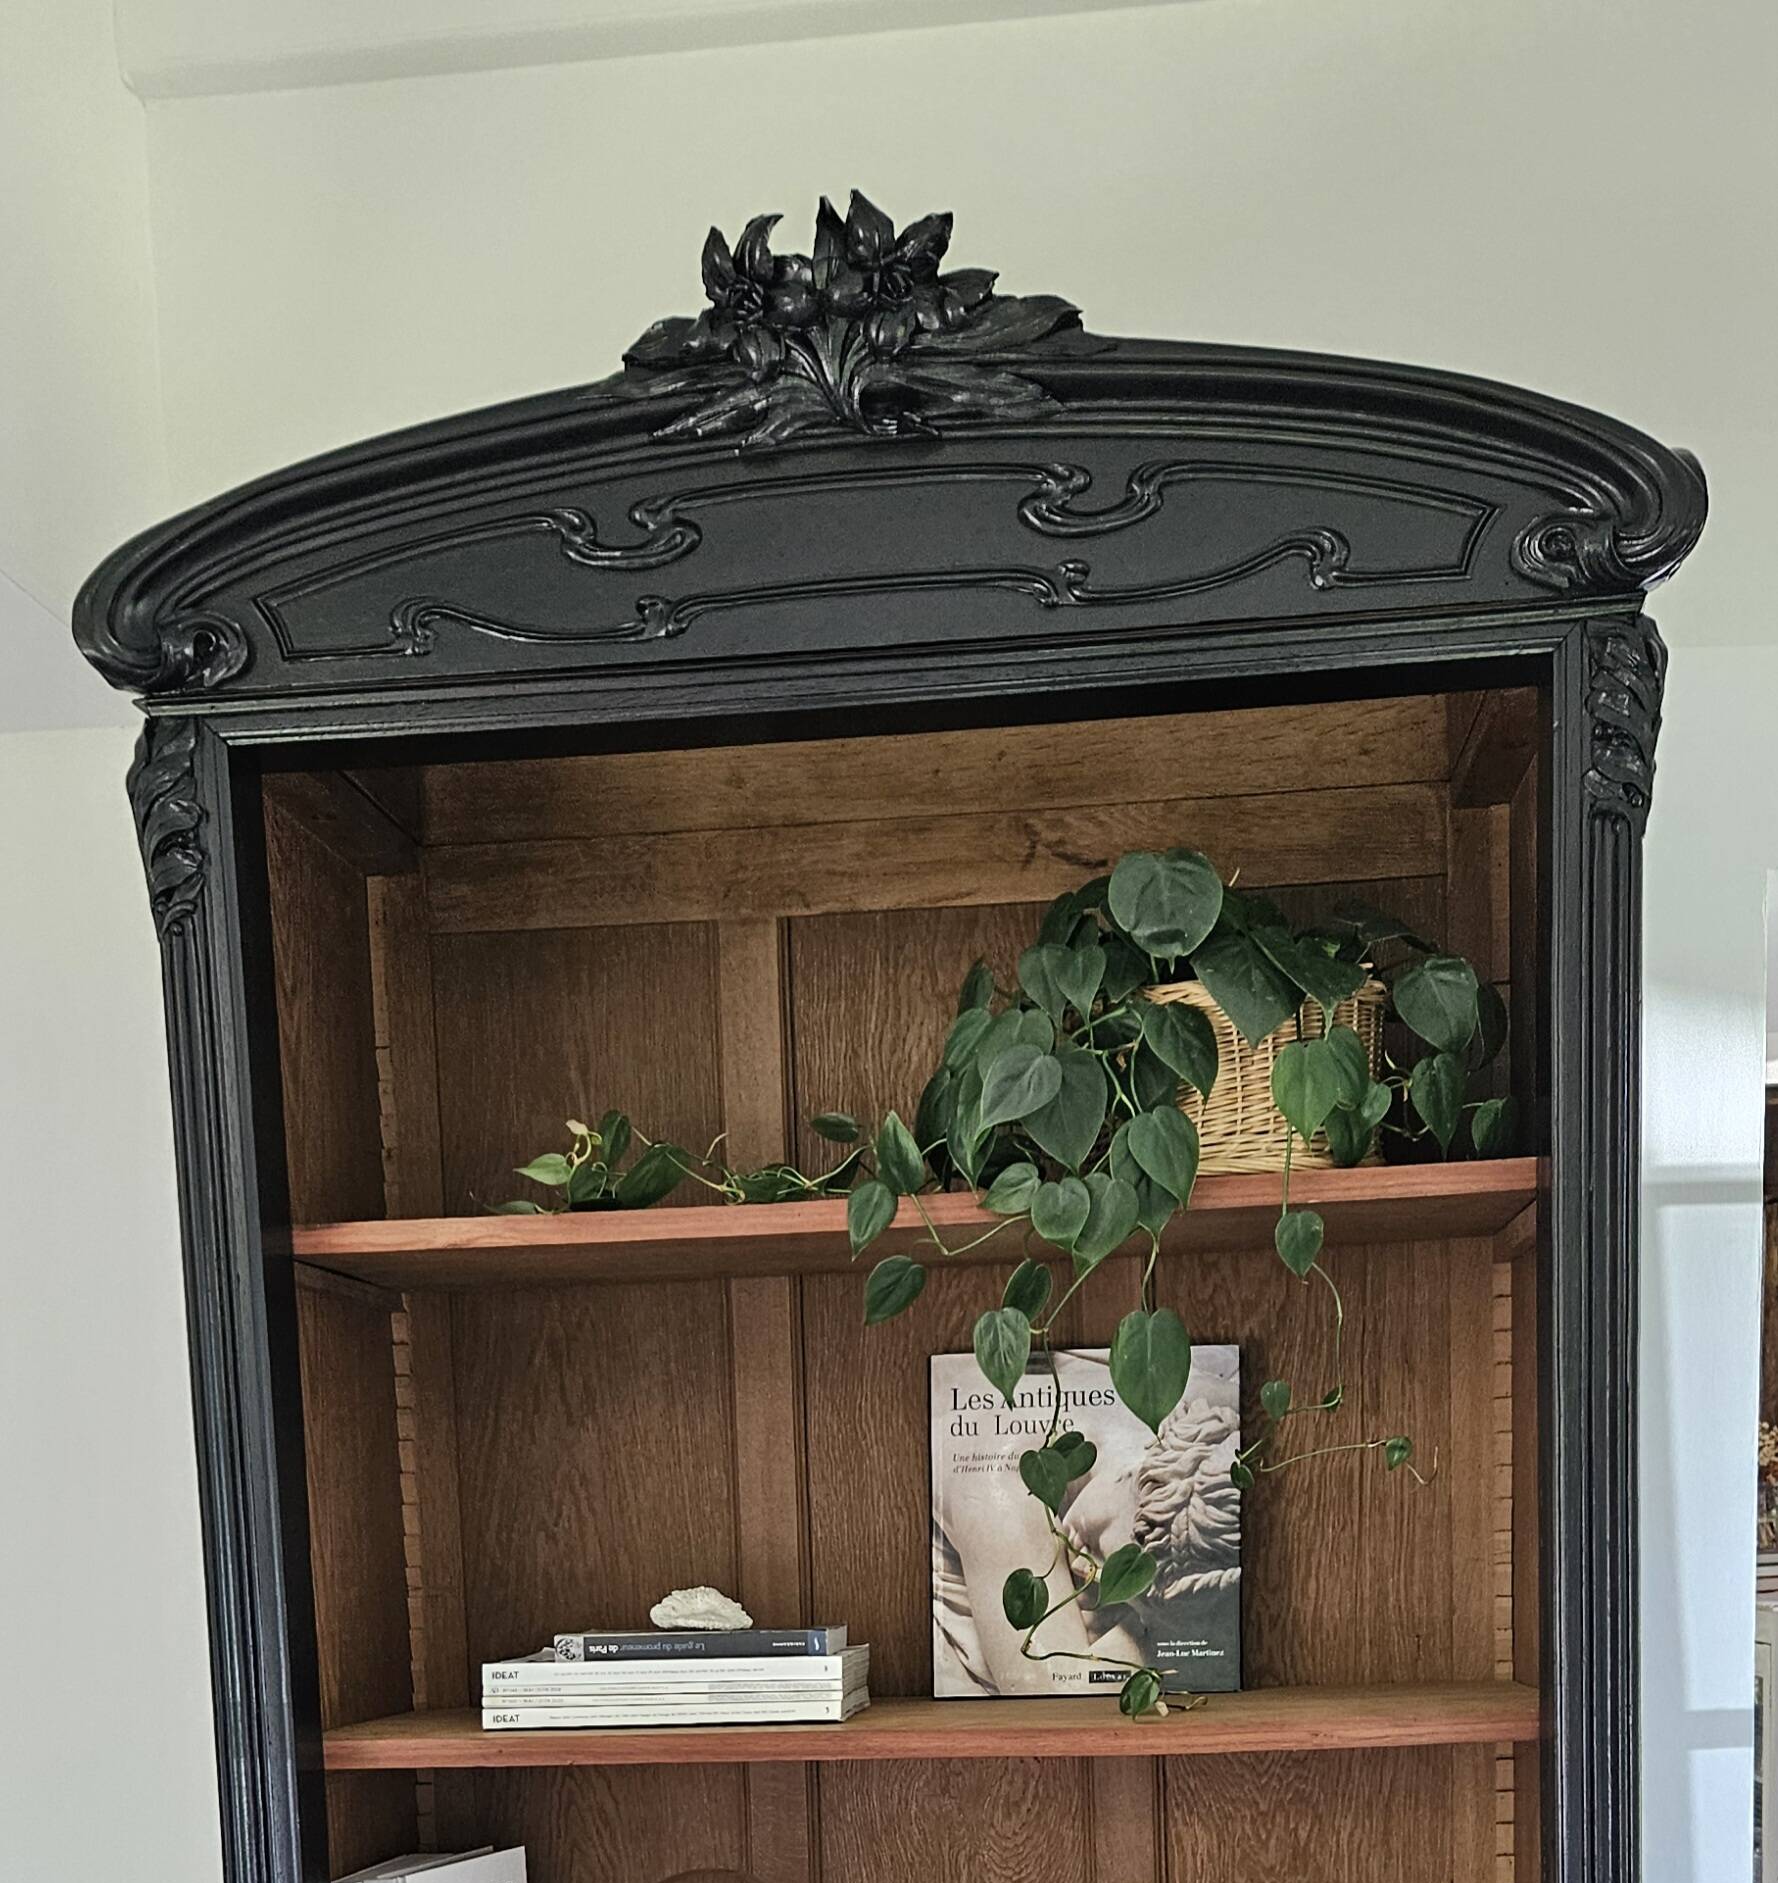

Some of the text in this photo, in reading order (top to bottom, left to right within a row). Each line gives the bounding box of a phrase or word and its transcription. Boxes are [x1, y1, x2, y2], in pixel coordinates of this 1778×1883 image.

[950, 1387, 994, 1411] Les
[950, 1413, 1074, 1436] du Louve
[952, 1453, 970, 1462] Une
[972, 1452, 1006, 1463] histoire
[589, 1644, 607, 1654] Paris
[608, 1644, 619, 1654] de
[662, 1642, 672, 1651] du
[695, 1642, 705, 1651] Le
[1156, 1648, 1224, 1657] Jean-Luc Martinez
[491, 1671, 519, 1680] IDEAT
[1052, 1672, 1082, 1682] Fayard
[492, 1714, 520, 1723] IDEAT
